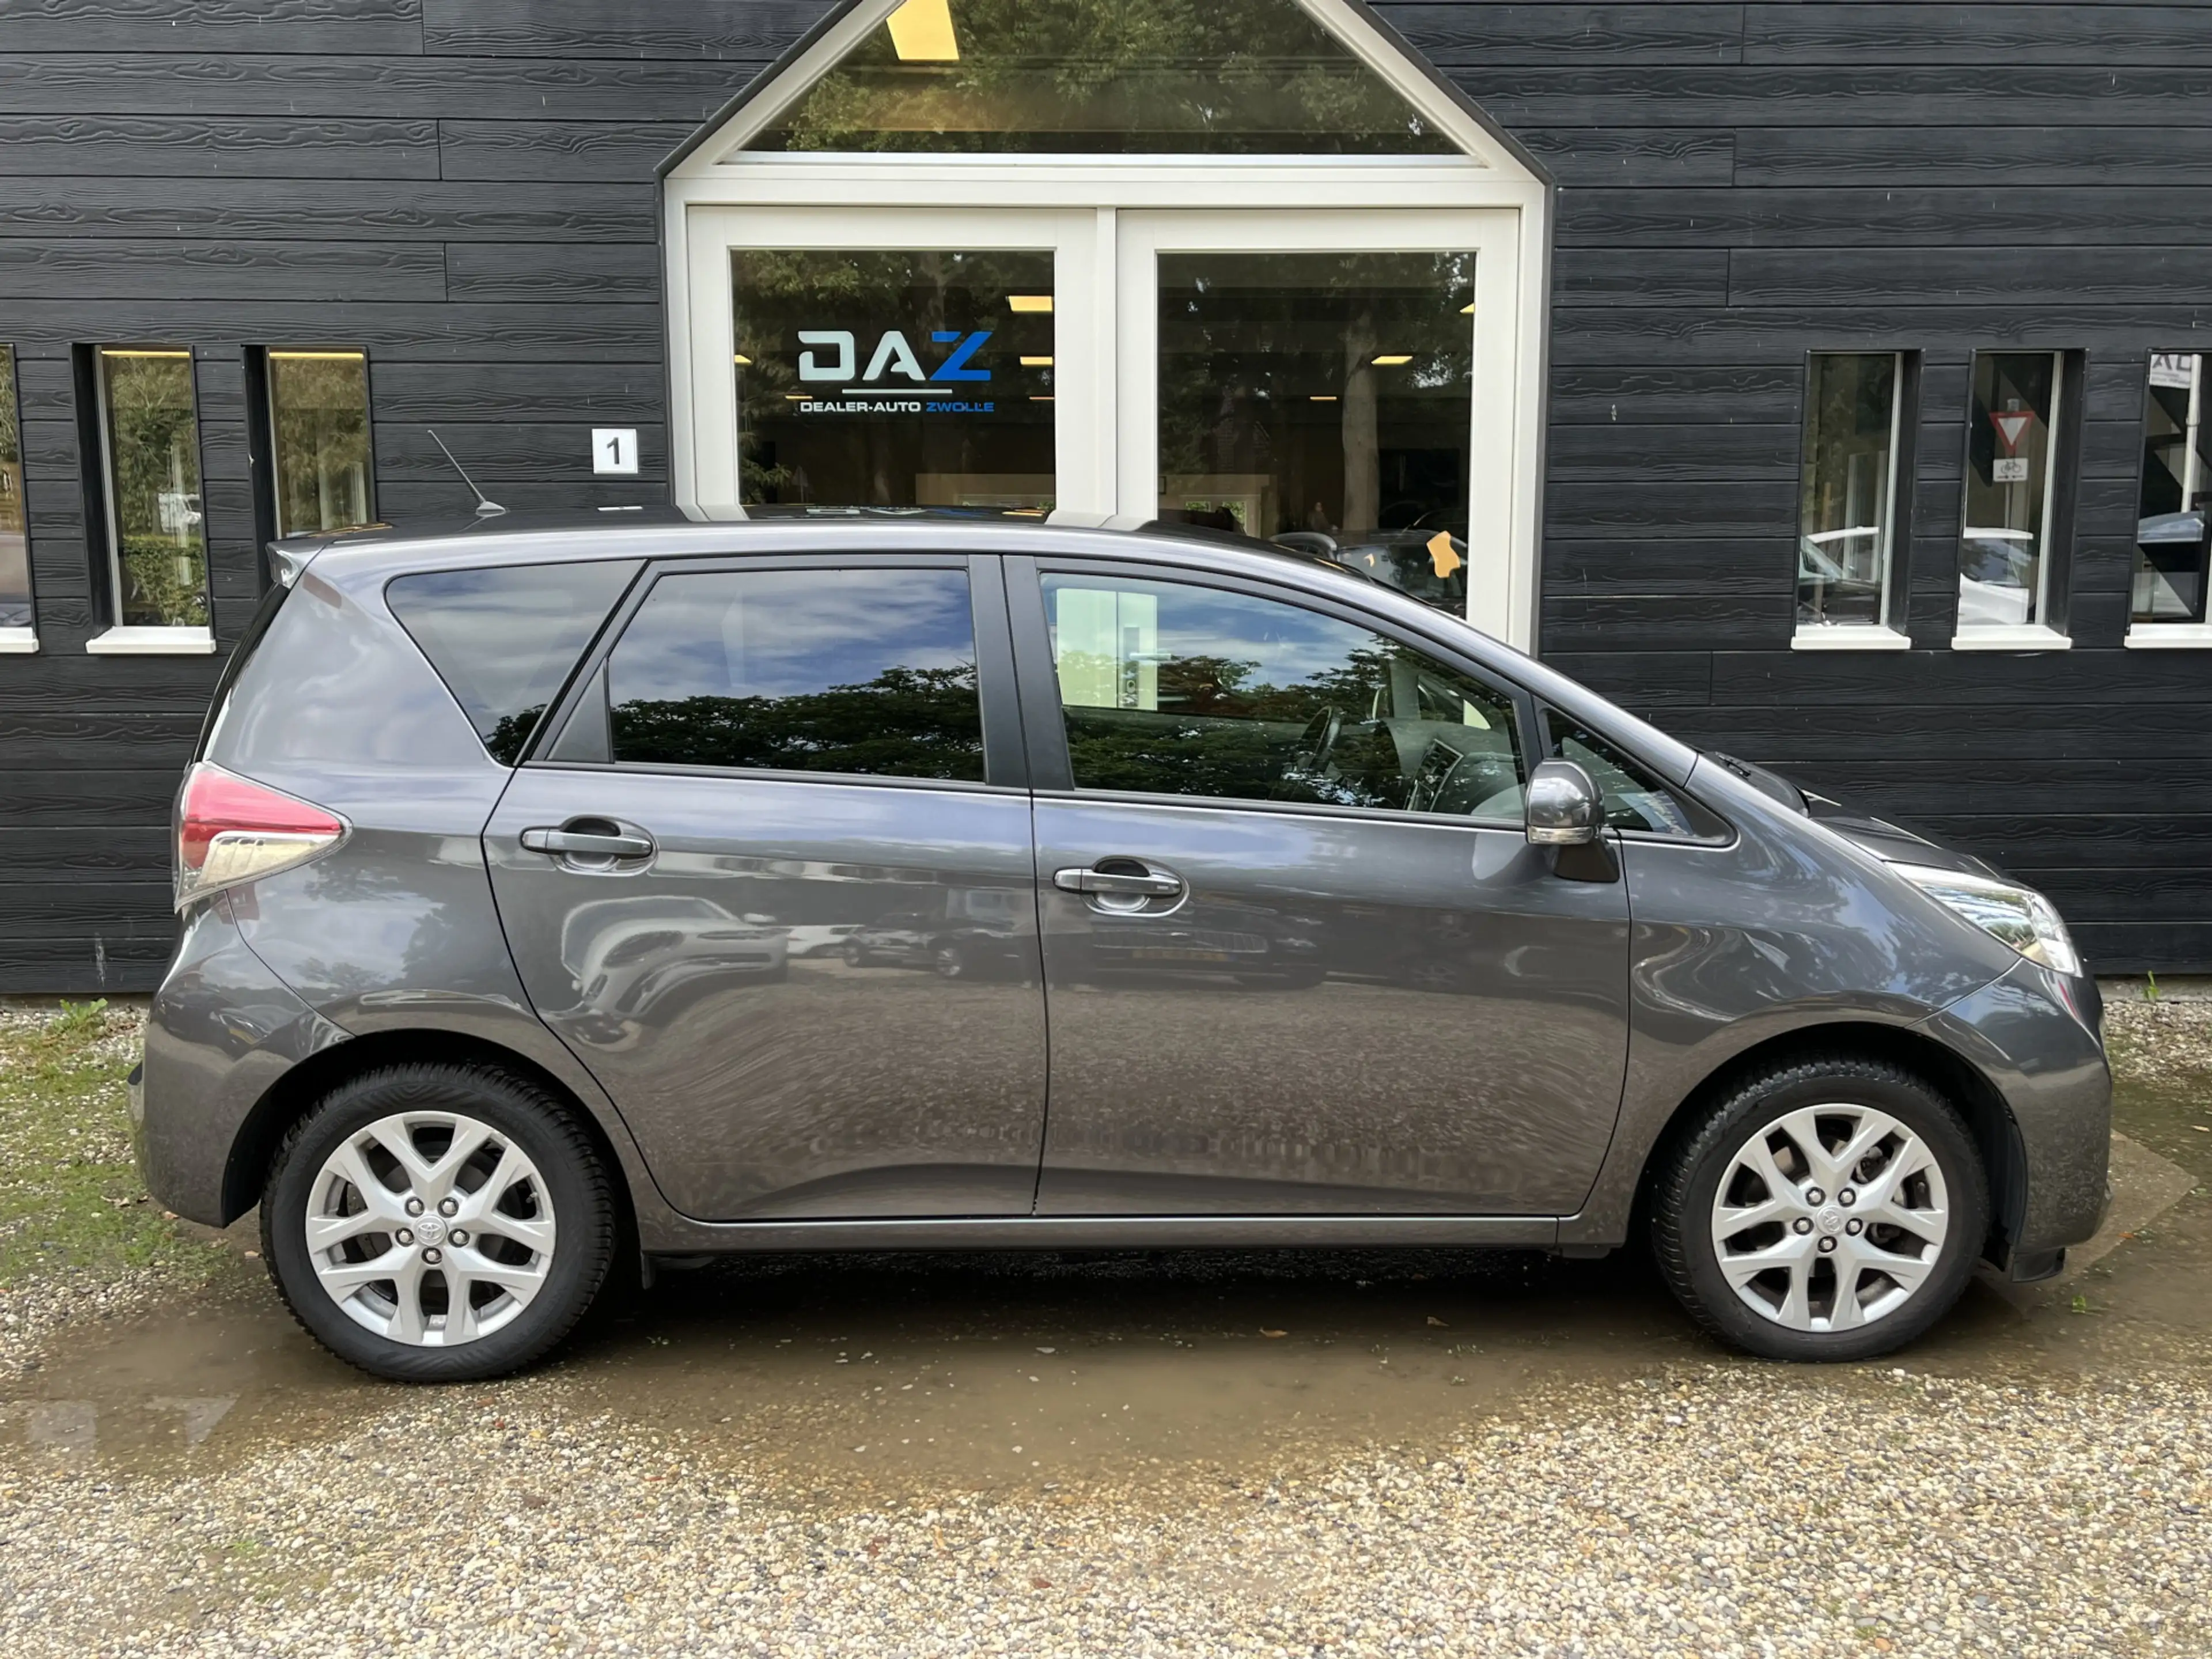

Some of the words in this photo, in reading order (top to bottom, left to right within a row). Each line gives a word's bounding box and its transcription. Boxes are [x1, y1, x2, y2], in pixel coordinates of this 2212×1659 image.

[798, 330, 993, 381] DAZ
[800, 402, 921, 412] DEALER-AUTO
[926, 402, 995, 412] ZWOLLE
[607, 436, 620, 465] 1
